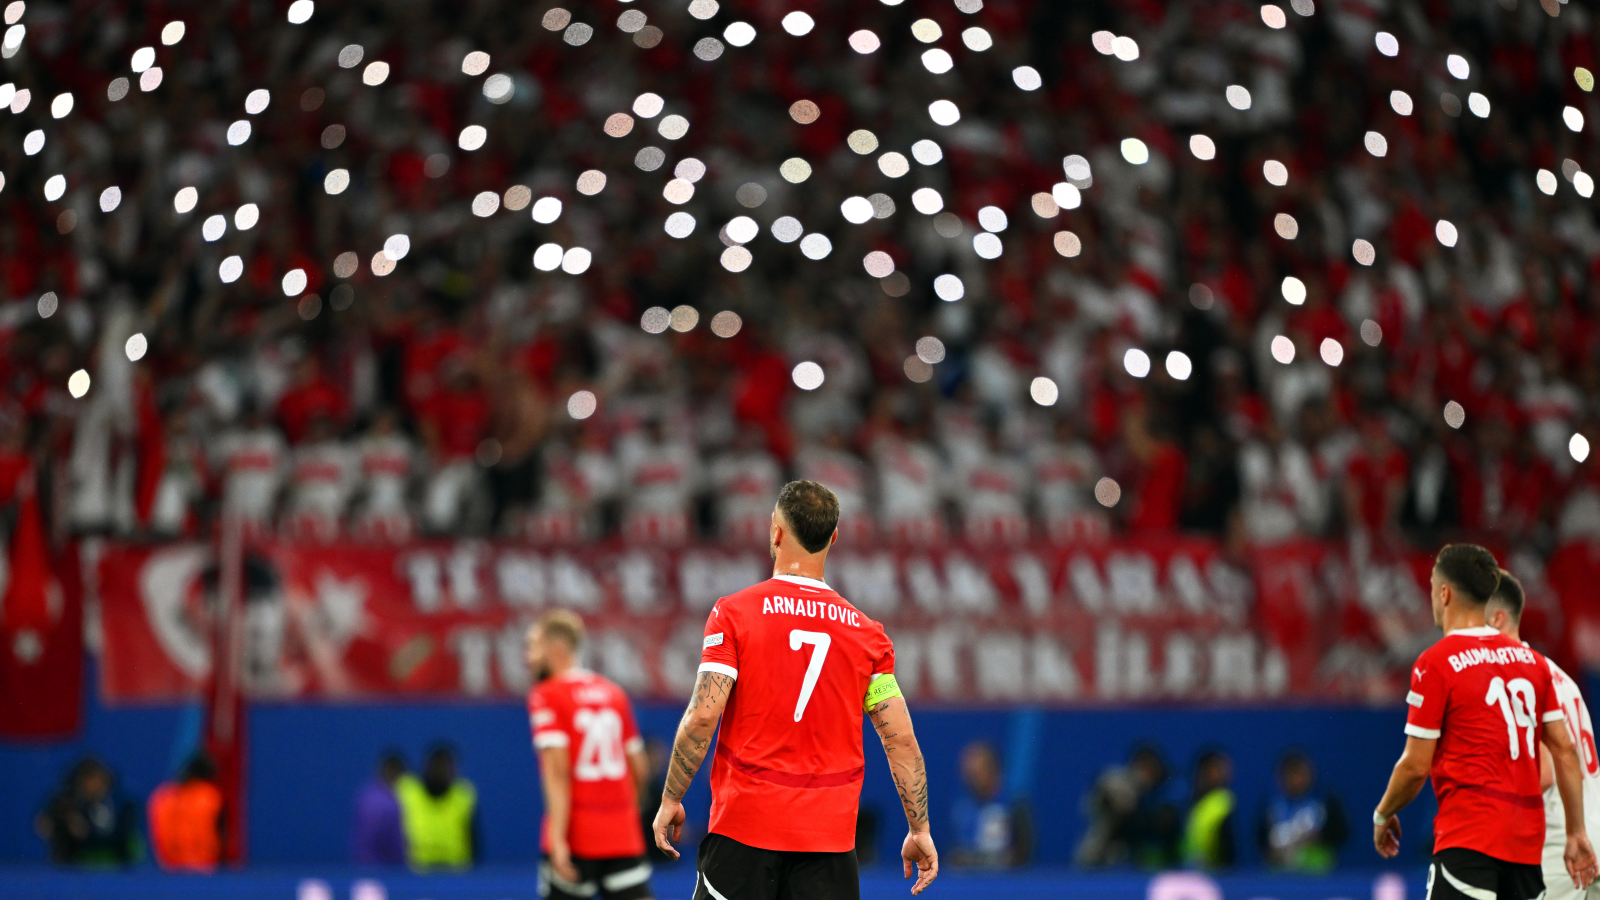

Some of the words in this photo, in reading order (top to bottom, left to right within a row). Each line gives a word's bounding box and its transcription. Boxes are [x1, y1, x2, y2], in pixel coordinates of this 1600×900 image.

[762, 595, 861, 628] ARNAUTOVIC
[789, 628, 832, 723] 7
[873, 680, 897, 696] RESPEC
[573, 707, 628, 781] 20
[1485, 676, 1538, 760] 19
